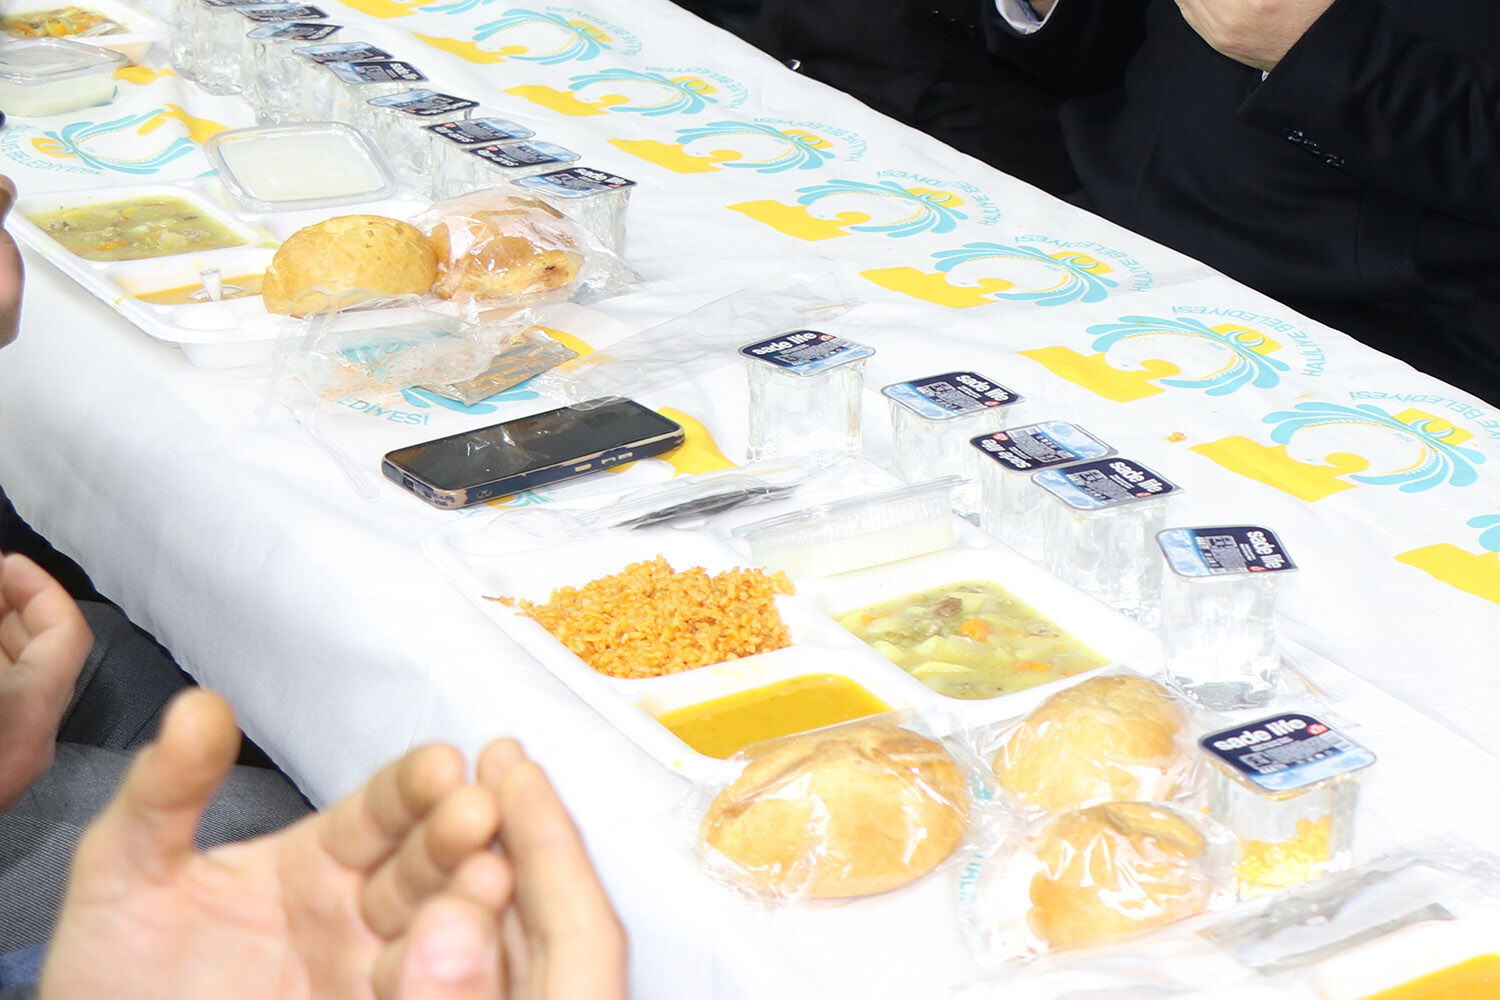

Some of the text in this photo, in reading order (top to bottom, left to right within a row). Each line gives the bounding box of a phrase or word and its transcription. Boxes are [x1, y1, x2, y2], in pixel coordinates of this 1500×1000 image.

[336, 397, 431, 426] EDİYESİ
[1109, 461, 1145, 483] sade
[1136, 478, 1164, 493] life
[1246, 530, 1285, 569] sade life
[1213, 718, 1307, 751] sade life
